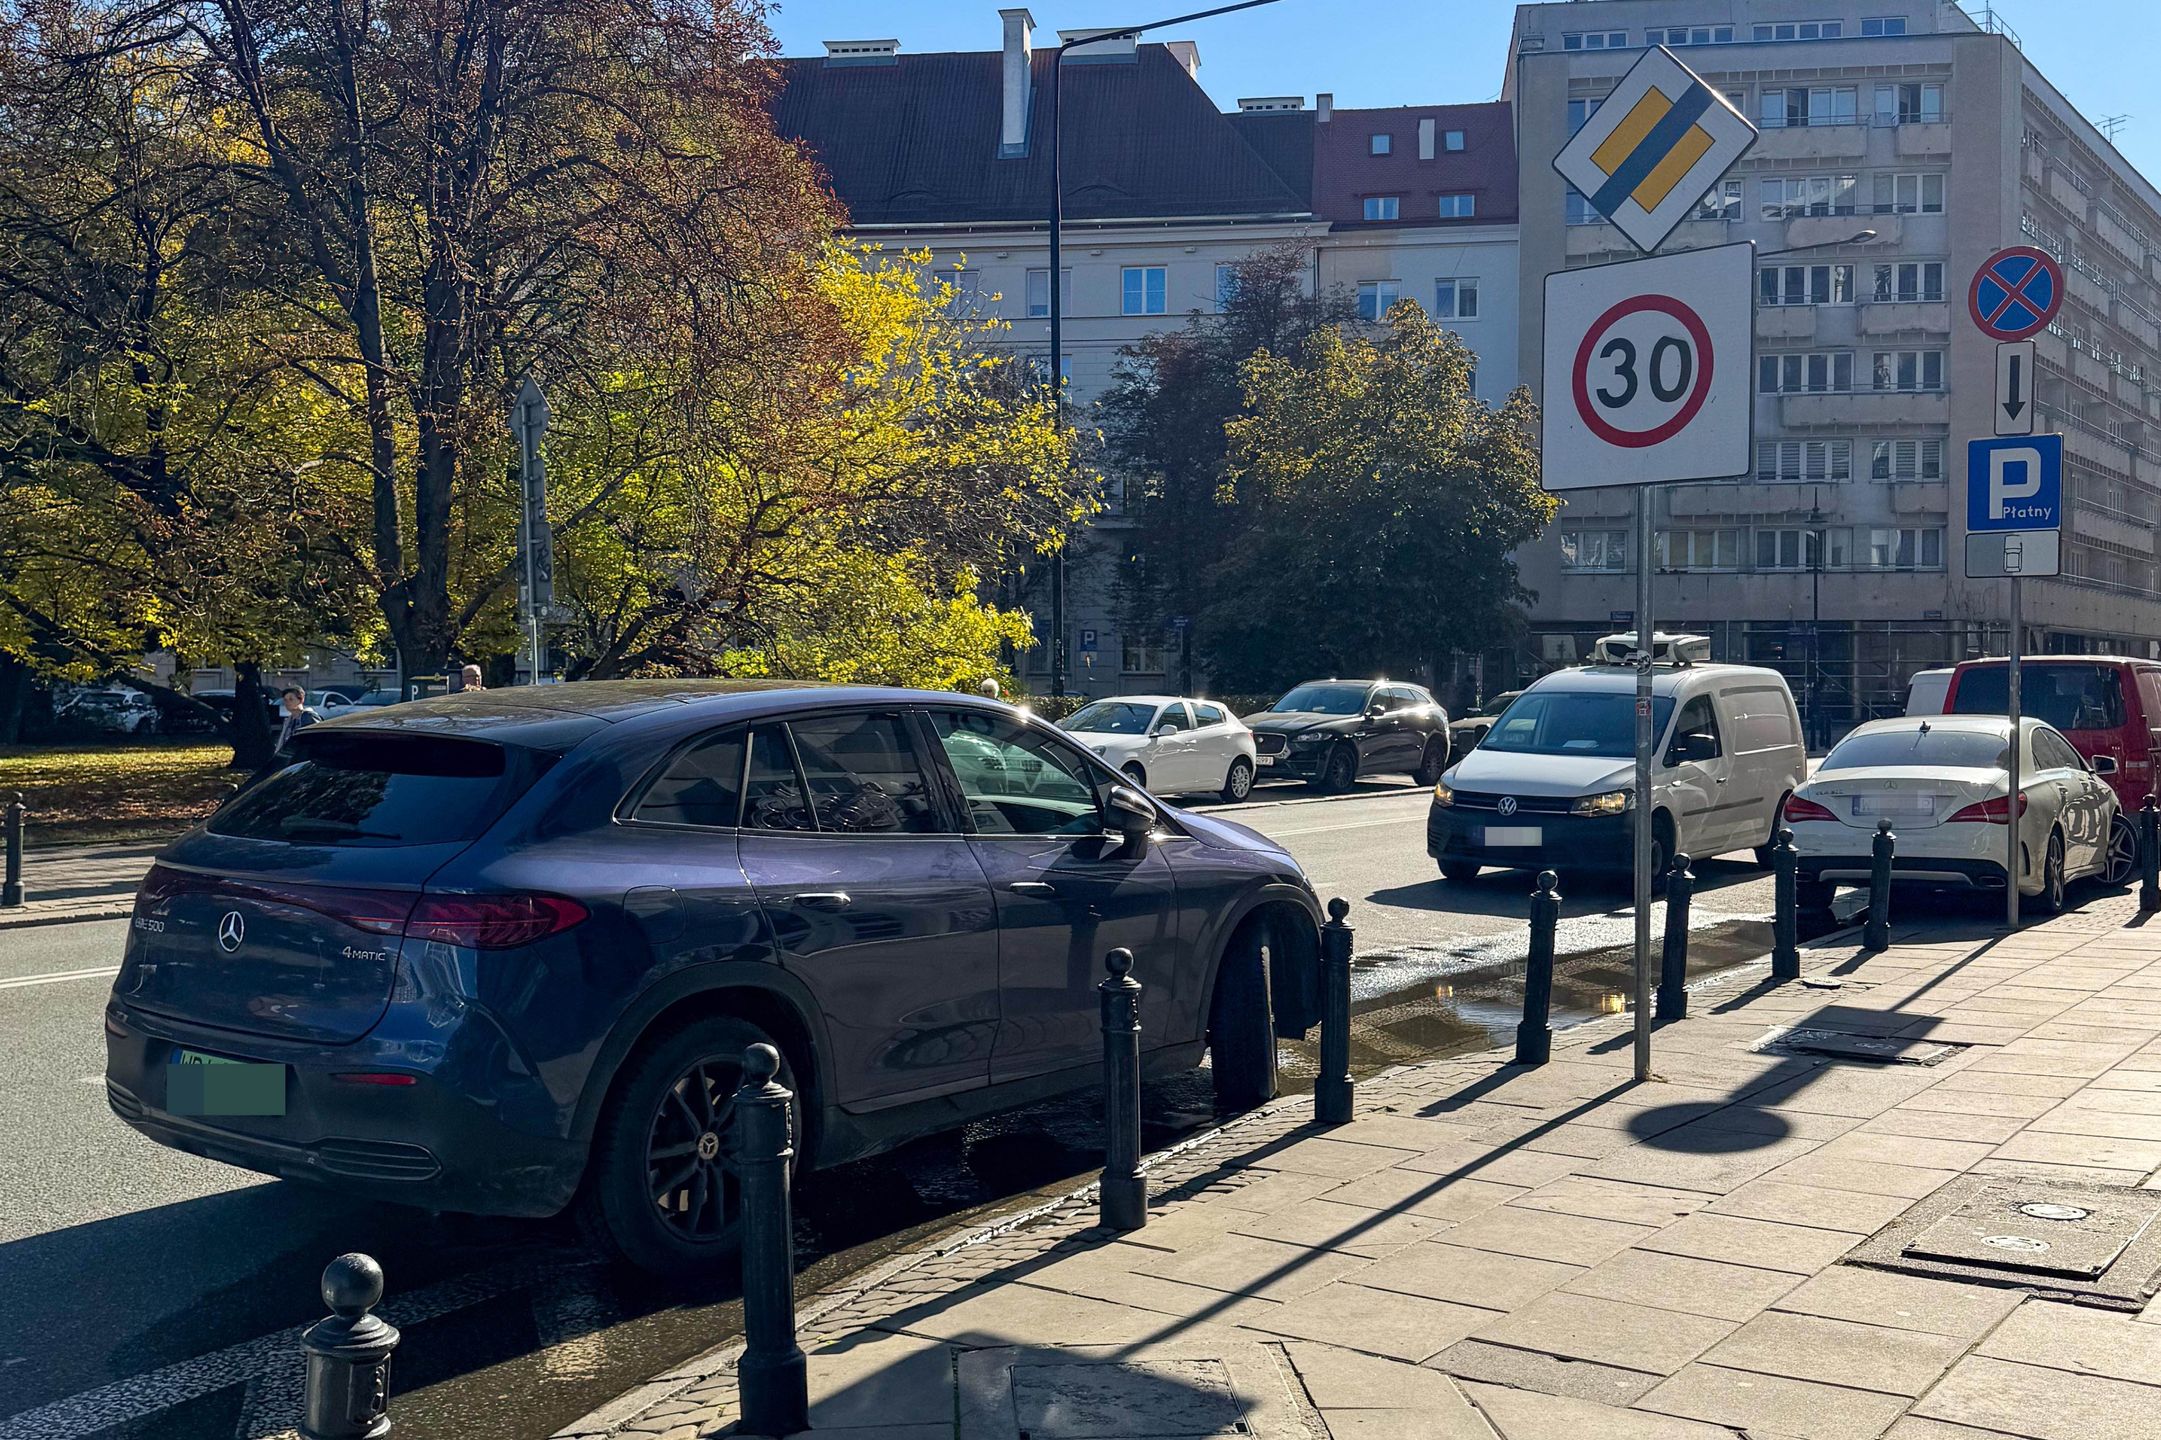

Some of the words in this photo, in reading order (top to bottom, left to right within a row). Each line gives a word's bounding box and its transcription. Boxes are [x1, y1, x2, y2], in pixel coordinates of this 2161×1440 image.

[1596, 335, 1692, 409] 30
[1989, 447, 2042, 519] P
[2003, 505, 2052, 520] Płatny
[1084, 631, 1095, 645] P
[148, 919, 165, 933] 500
[342, 945, 386, 961] 4MATIC
